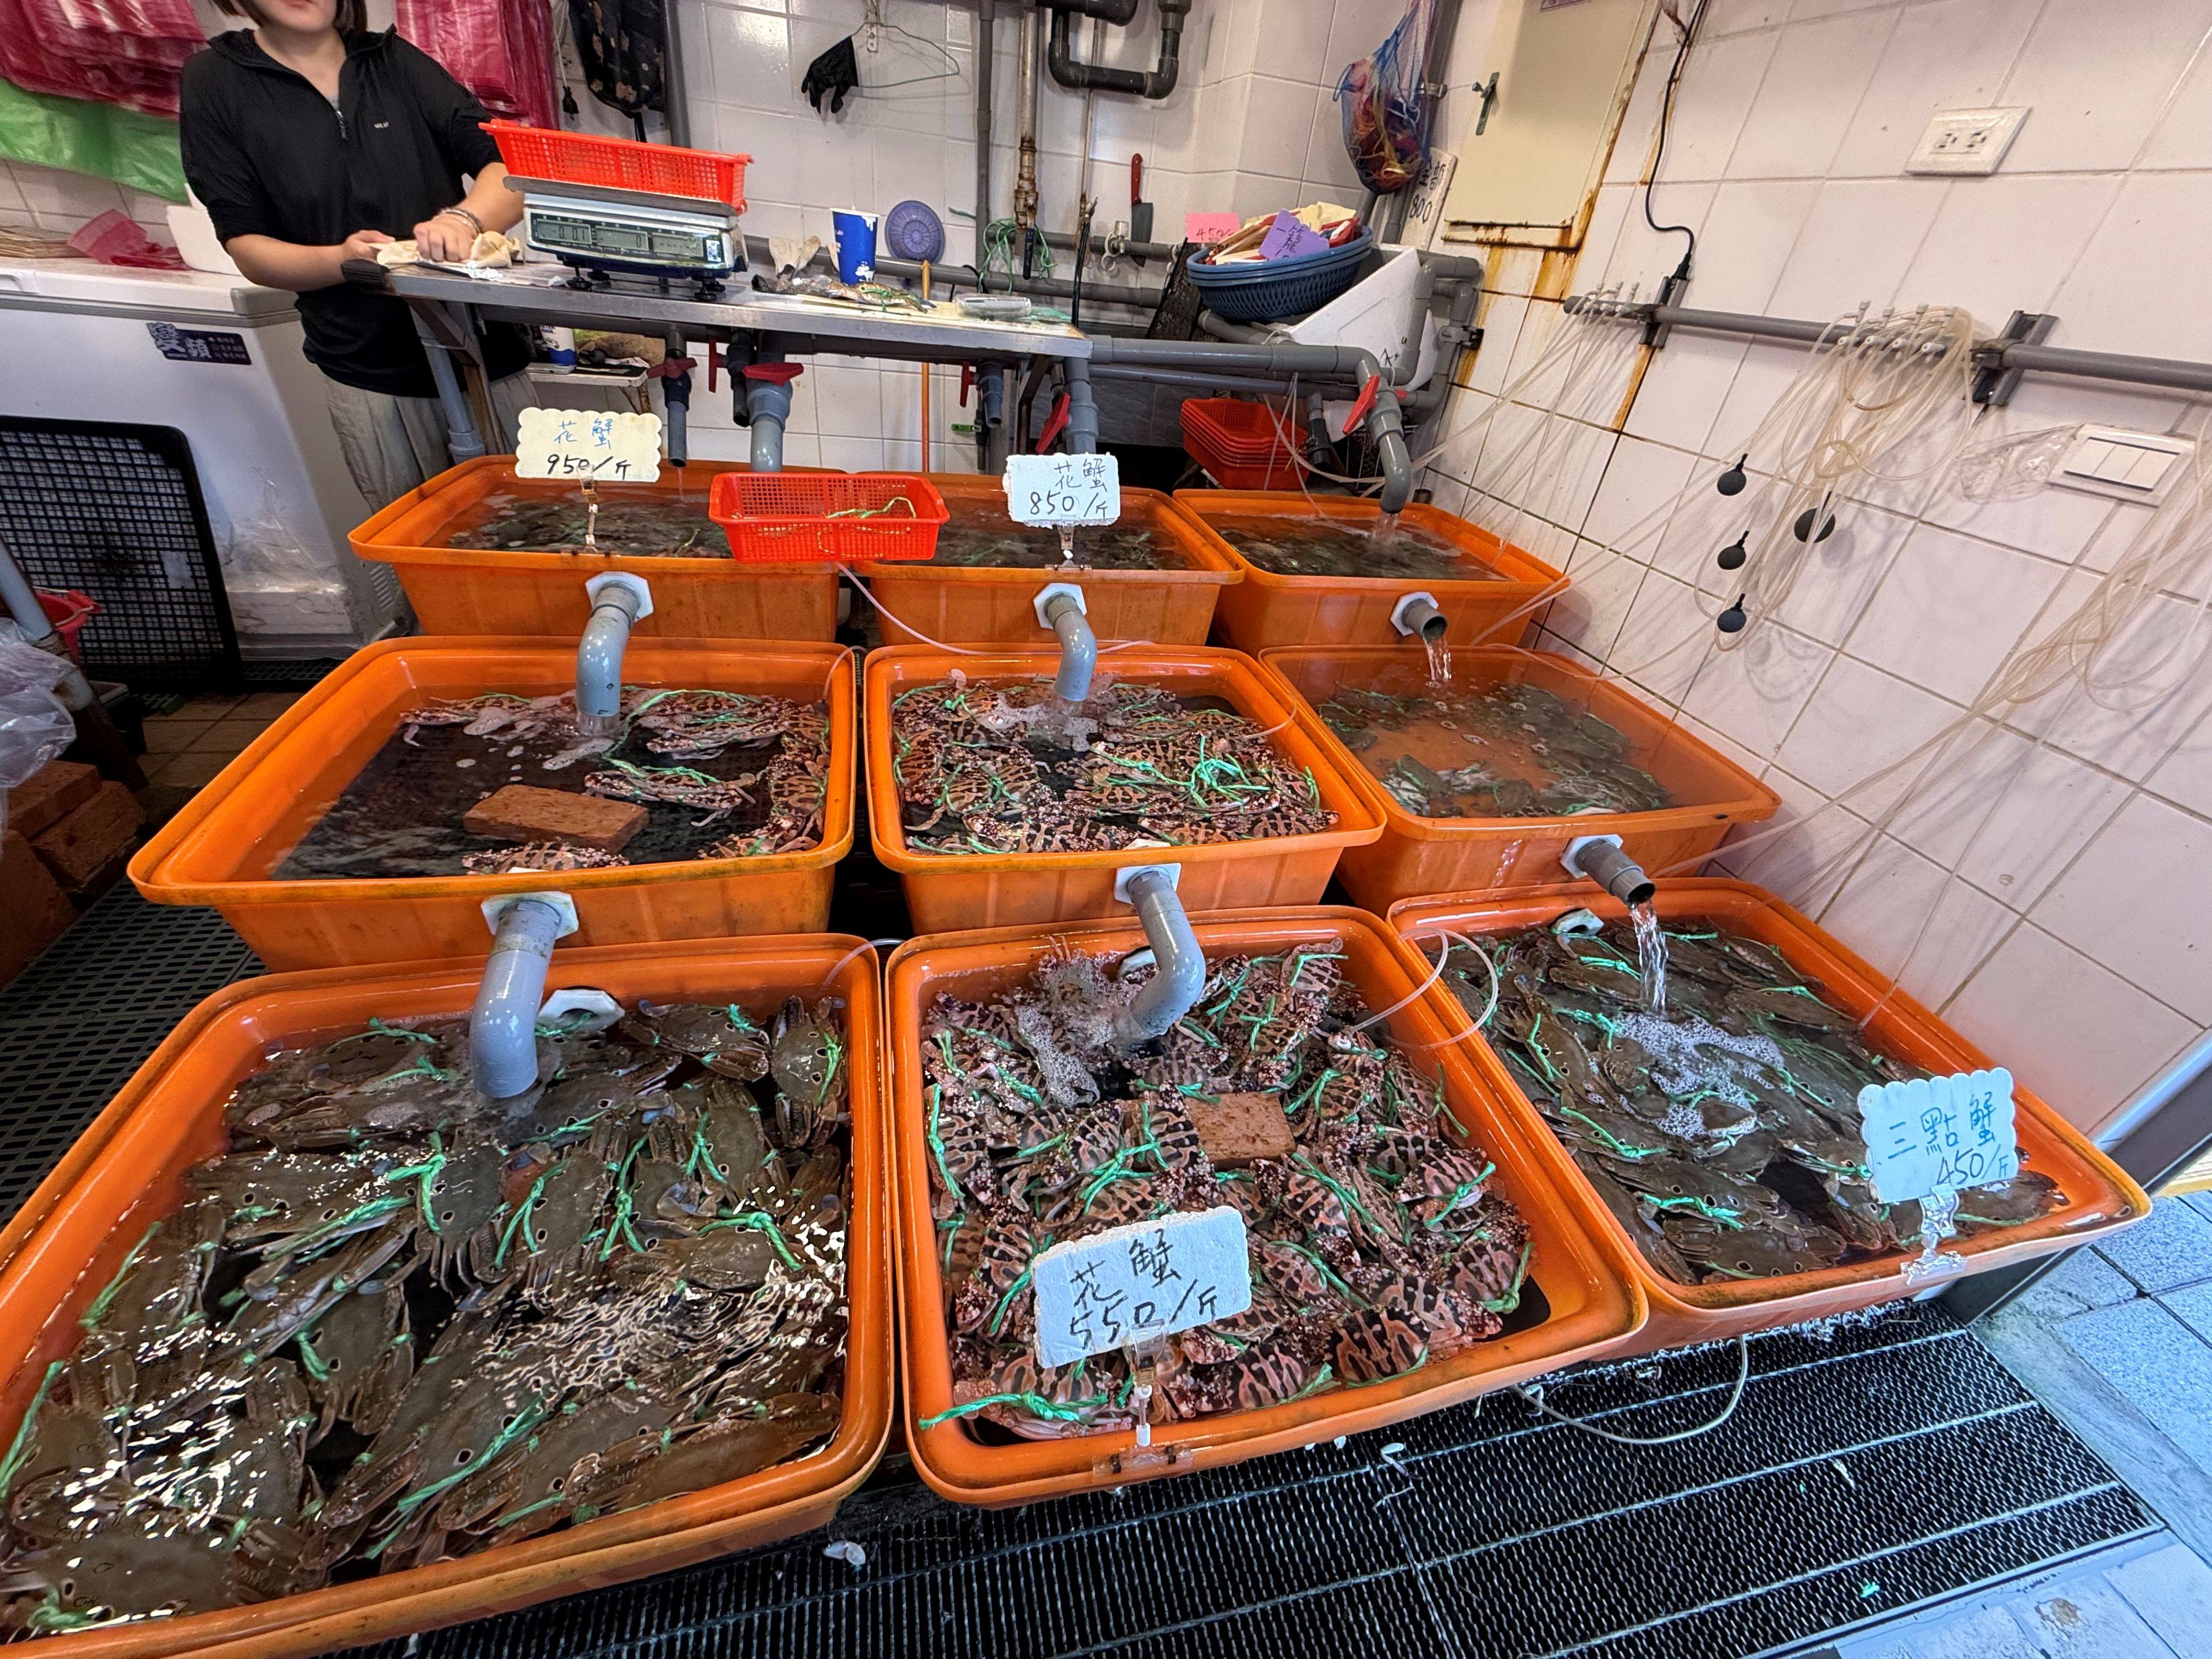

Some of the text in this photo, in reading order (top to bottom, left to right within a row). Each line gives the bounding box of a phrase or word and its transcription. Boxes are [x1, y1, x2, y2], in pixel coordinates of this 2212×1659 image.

[1409, 193, 1432, 224] 800
[554, 418, 613, 449] 花蟹
[1053, 458, 1108, 492] 花蟹
[1030, 490, 1108, 519] 850/斤
[1888, 1091, 1997, 1160] 三點蟹
[1070, 1228, 1182, 1310] 花蟹
